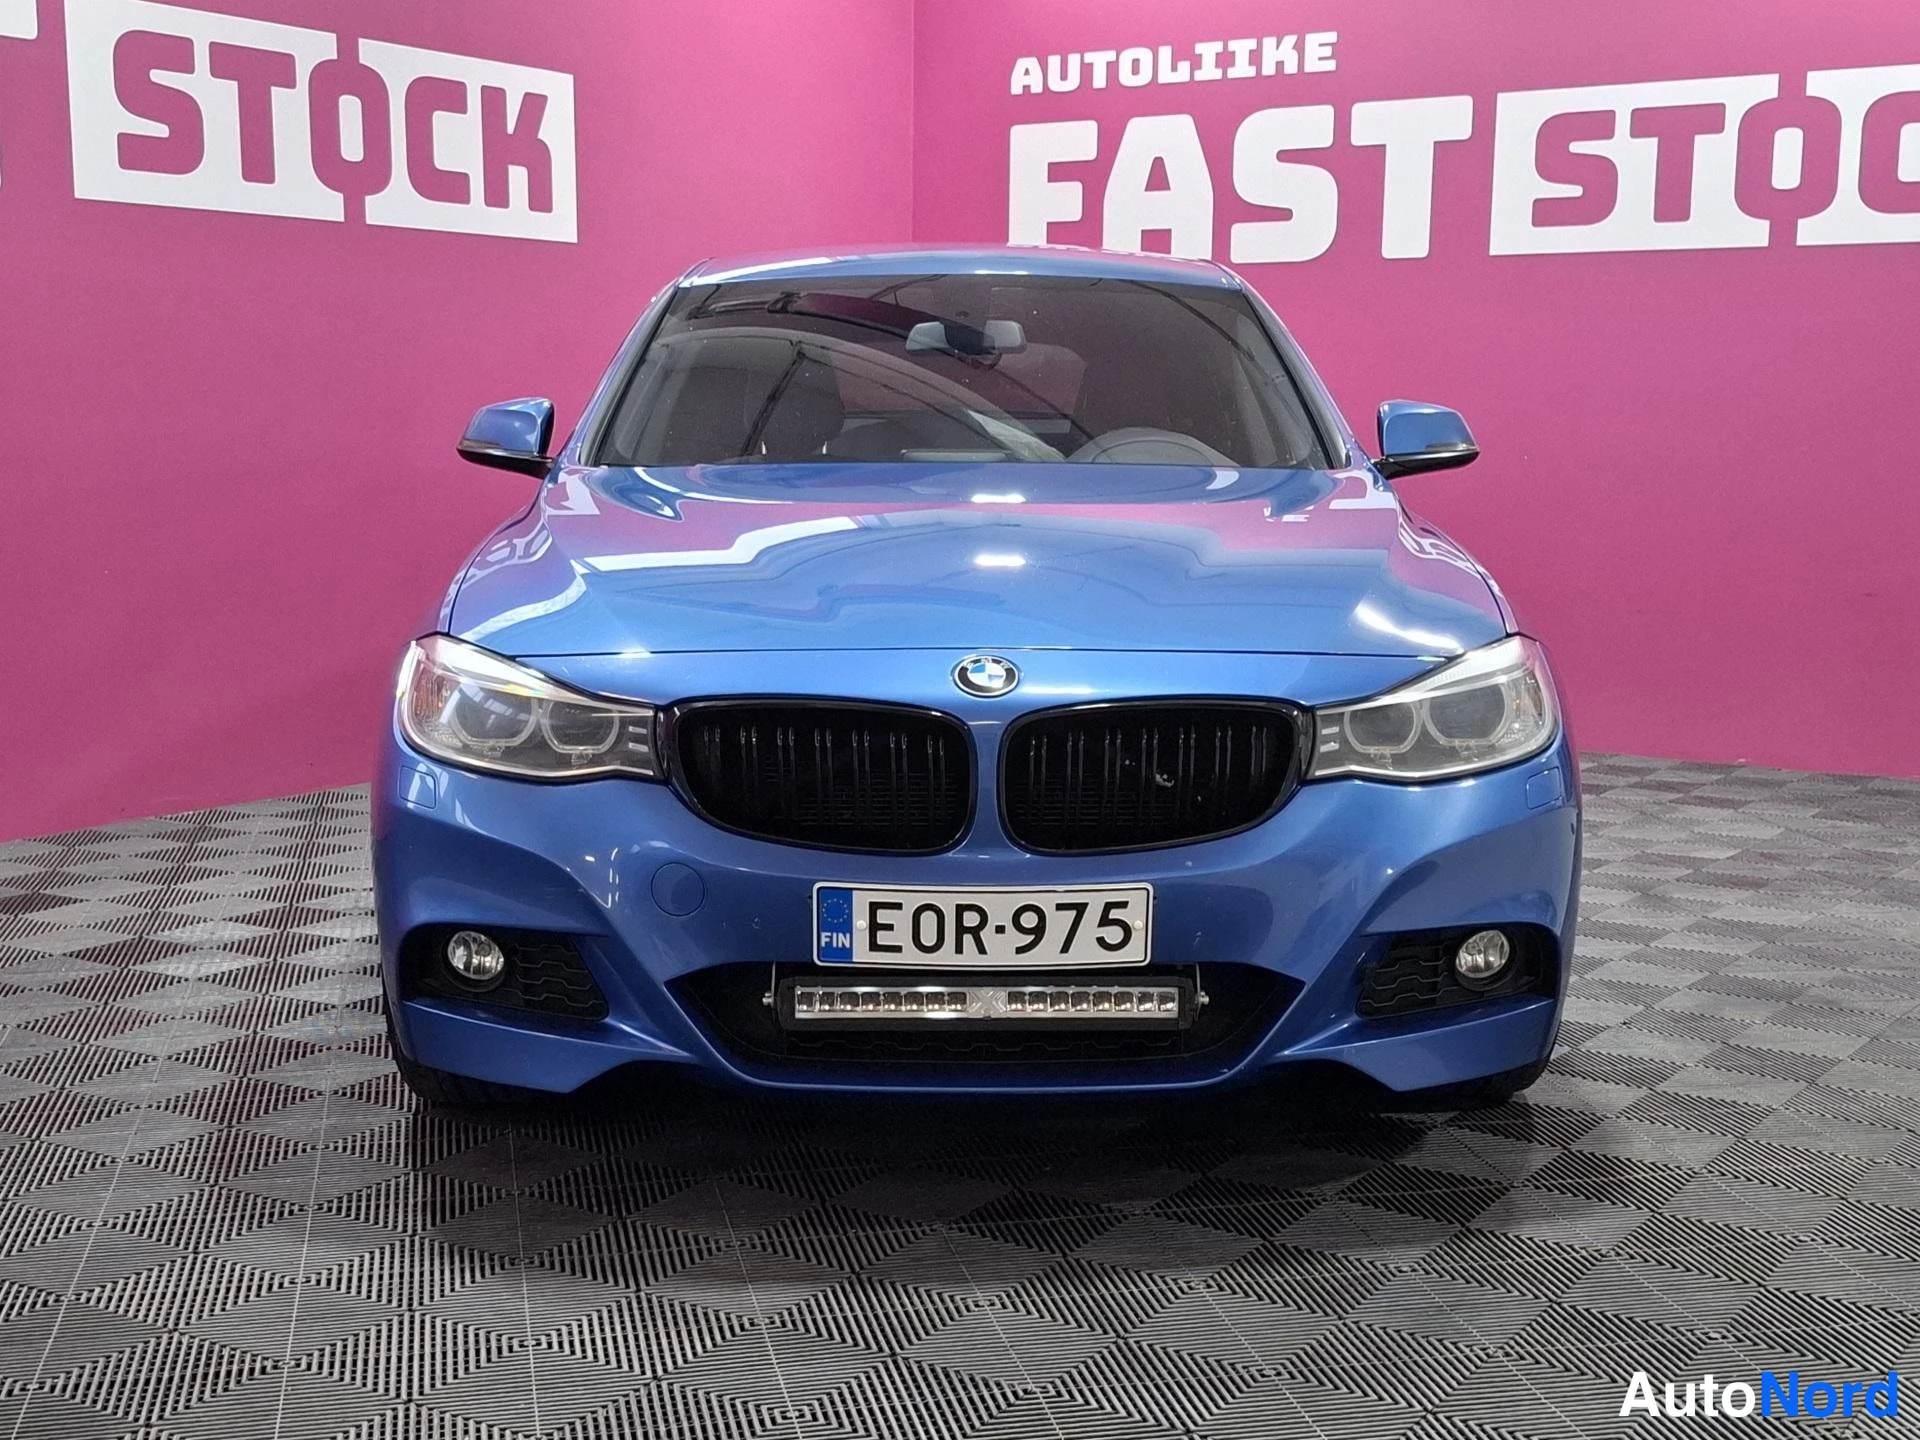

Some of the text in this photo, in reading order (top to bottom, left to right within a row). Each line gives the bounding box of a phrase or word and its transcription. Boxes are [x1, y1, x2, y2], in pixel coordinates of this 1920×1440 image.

[1010, 31, 1338, 95] AUTOLIIKE
[113, 29, 553, 214] STOCK
[1008, 95, 1474, 264] FAST
[820, 932, 850, 948] FIN
[868, 900, 1133, 955] EOR-975
